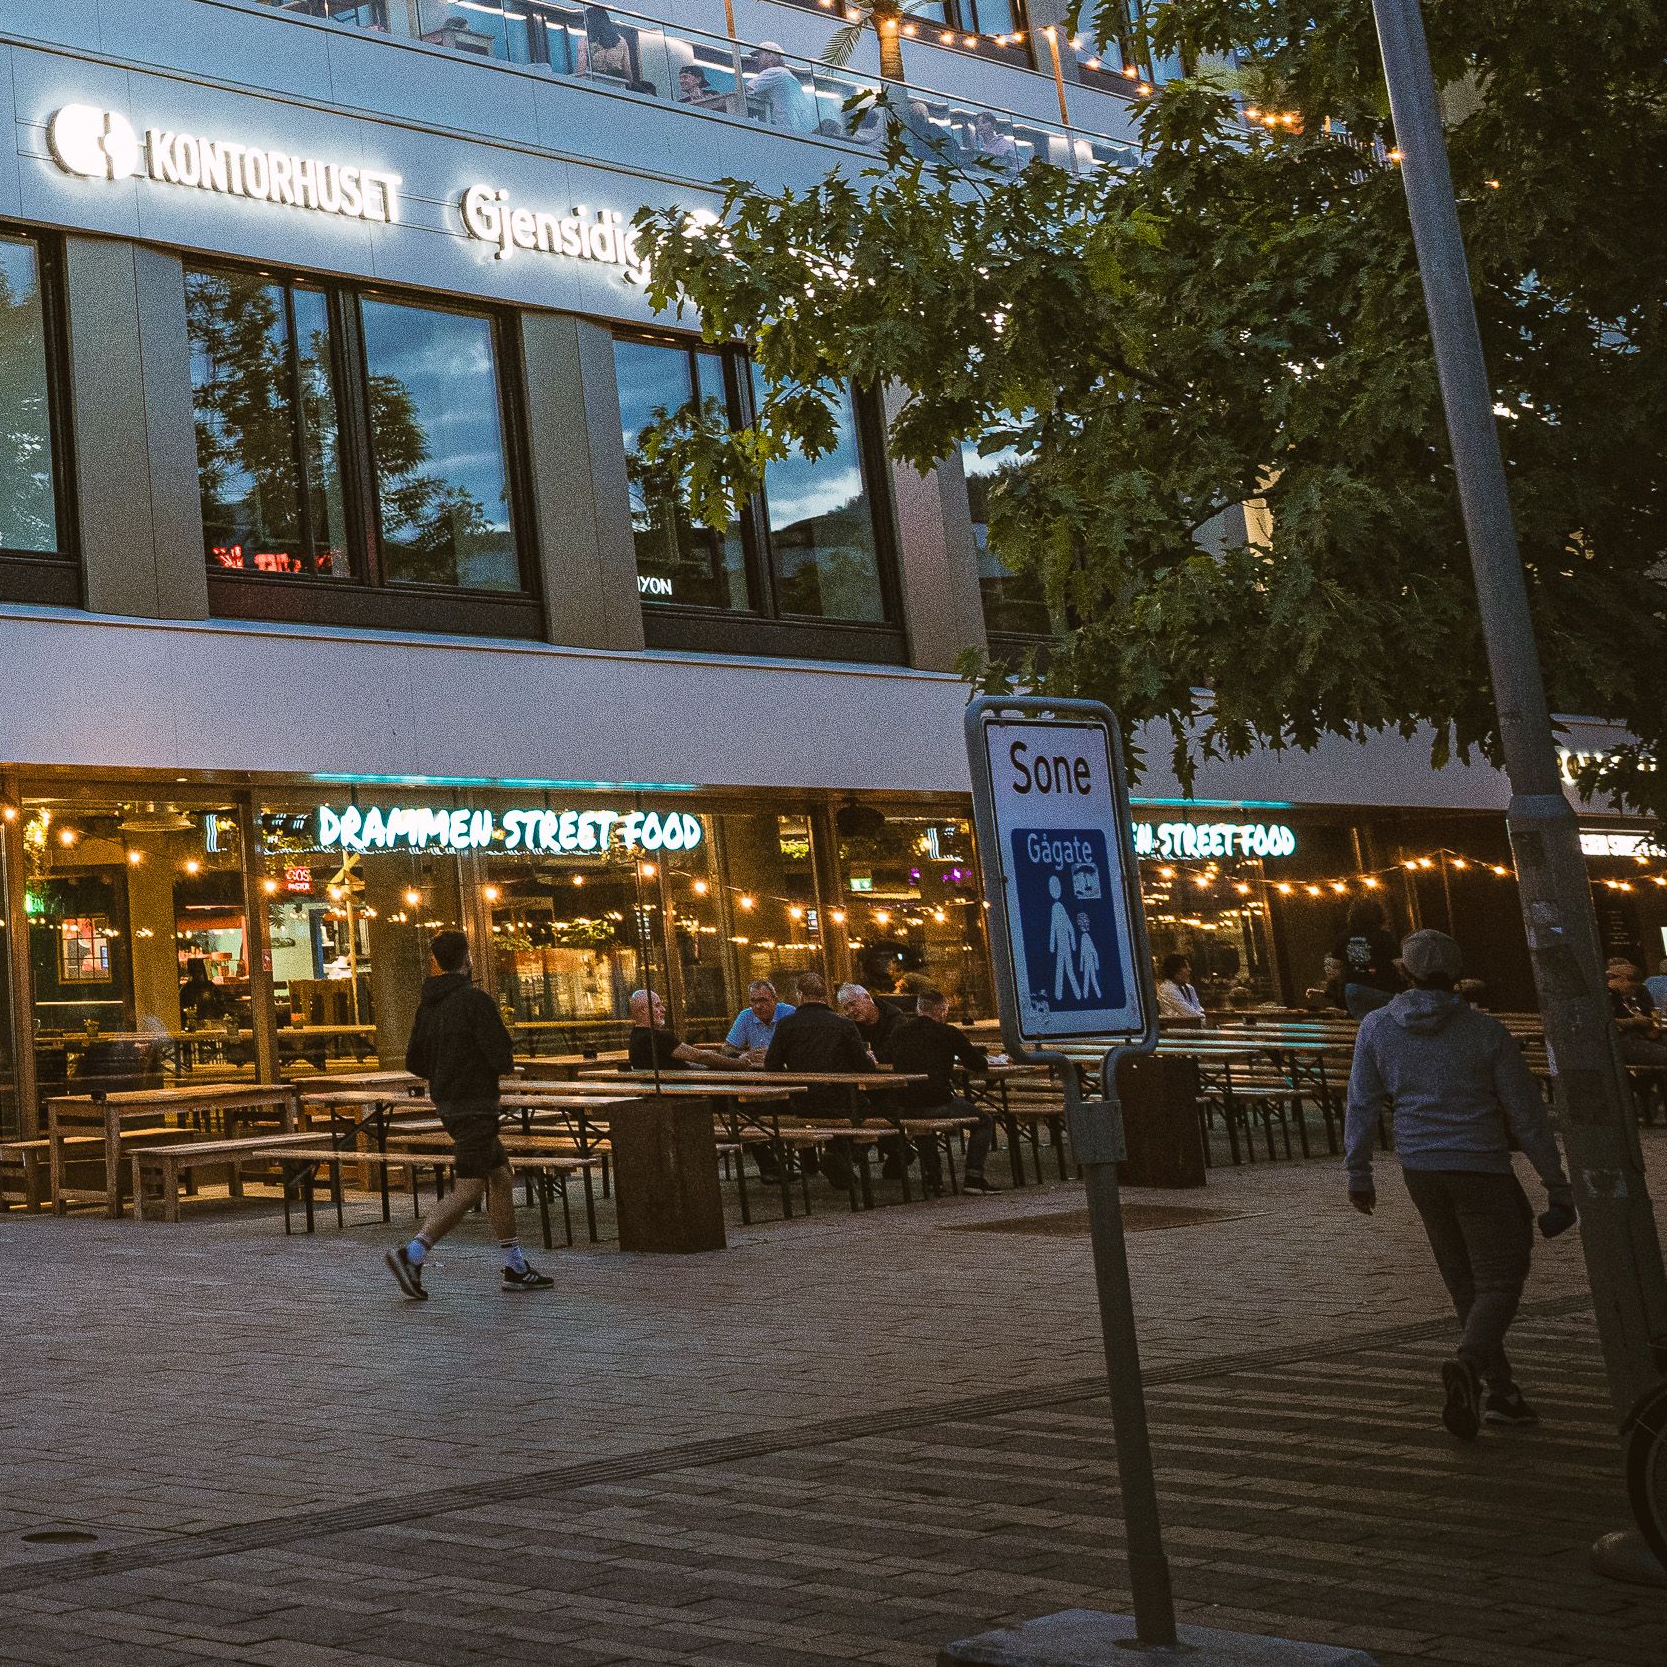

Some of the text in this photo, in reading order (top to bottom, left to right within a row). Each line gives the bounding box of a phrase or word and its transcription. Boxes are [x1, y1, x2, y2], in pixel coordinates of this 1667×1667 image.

[146, 129, 402, 222] KONTORHUSET
[461, 184, 661, 284] Gjensidig
[1009, 741, 1092, 796] Sone
[319, 805, 702, 852] DRAMMEN STREET FOOD
[1027, 833, 1093, 871] Gågate
[1157, 823, 1234, 857] STREET
[1238, 823, 1296, 857] FOOD
